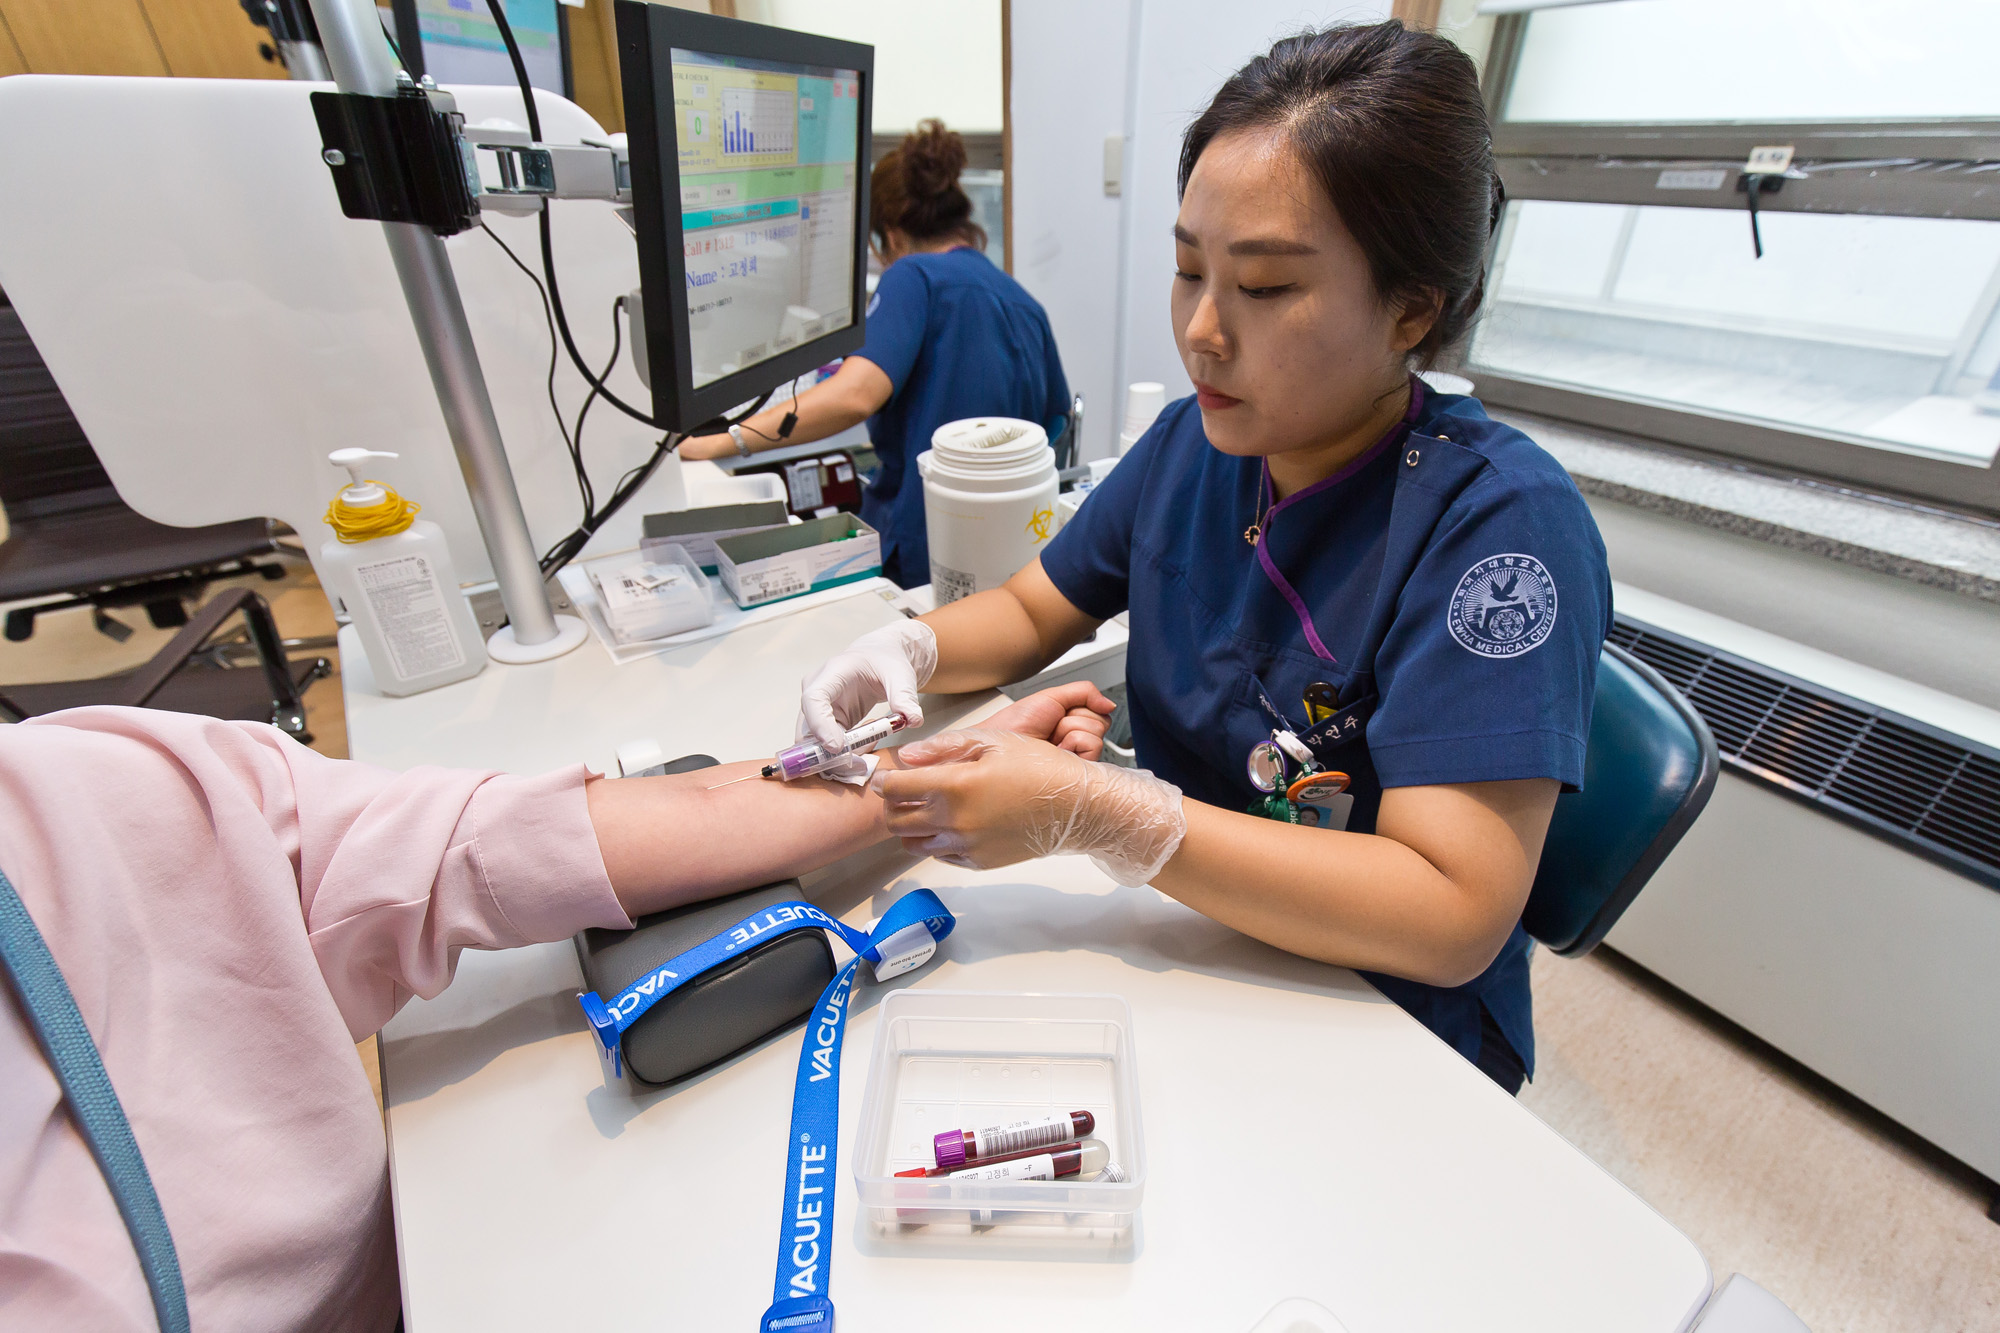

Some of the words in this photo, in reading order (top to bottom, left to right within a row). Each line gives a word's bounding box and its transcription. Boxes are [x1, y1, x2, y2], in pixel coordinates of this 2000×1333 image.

[684, 241, 702, 258] Call
[705, 240, 711, 253] #
[714, 235, 735, 252] 1312
[685, 270, 718, 290] Name
[1452, 618, 1475, 646] EWHA
[1475, 639, 1531, 655] MEDICAL
[1530, 606, 1554, 642] CENTER
[910, 947, 932, 960] greiner
[985, 1167, 1010, 1180] 고정희
[1024, 1164, 1032, 1172] -F
